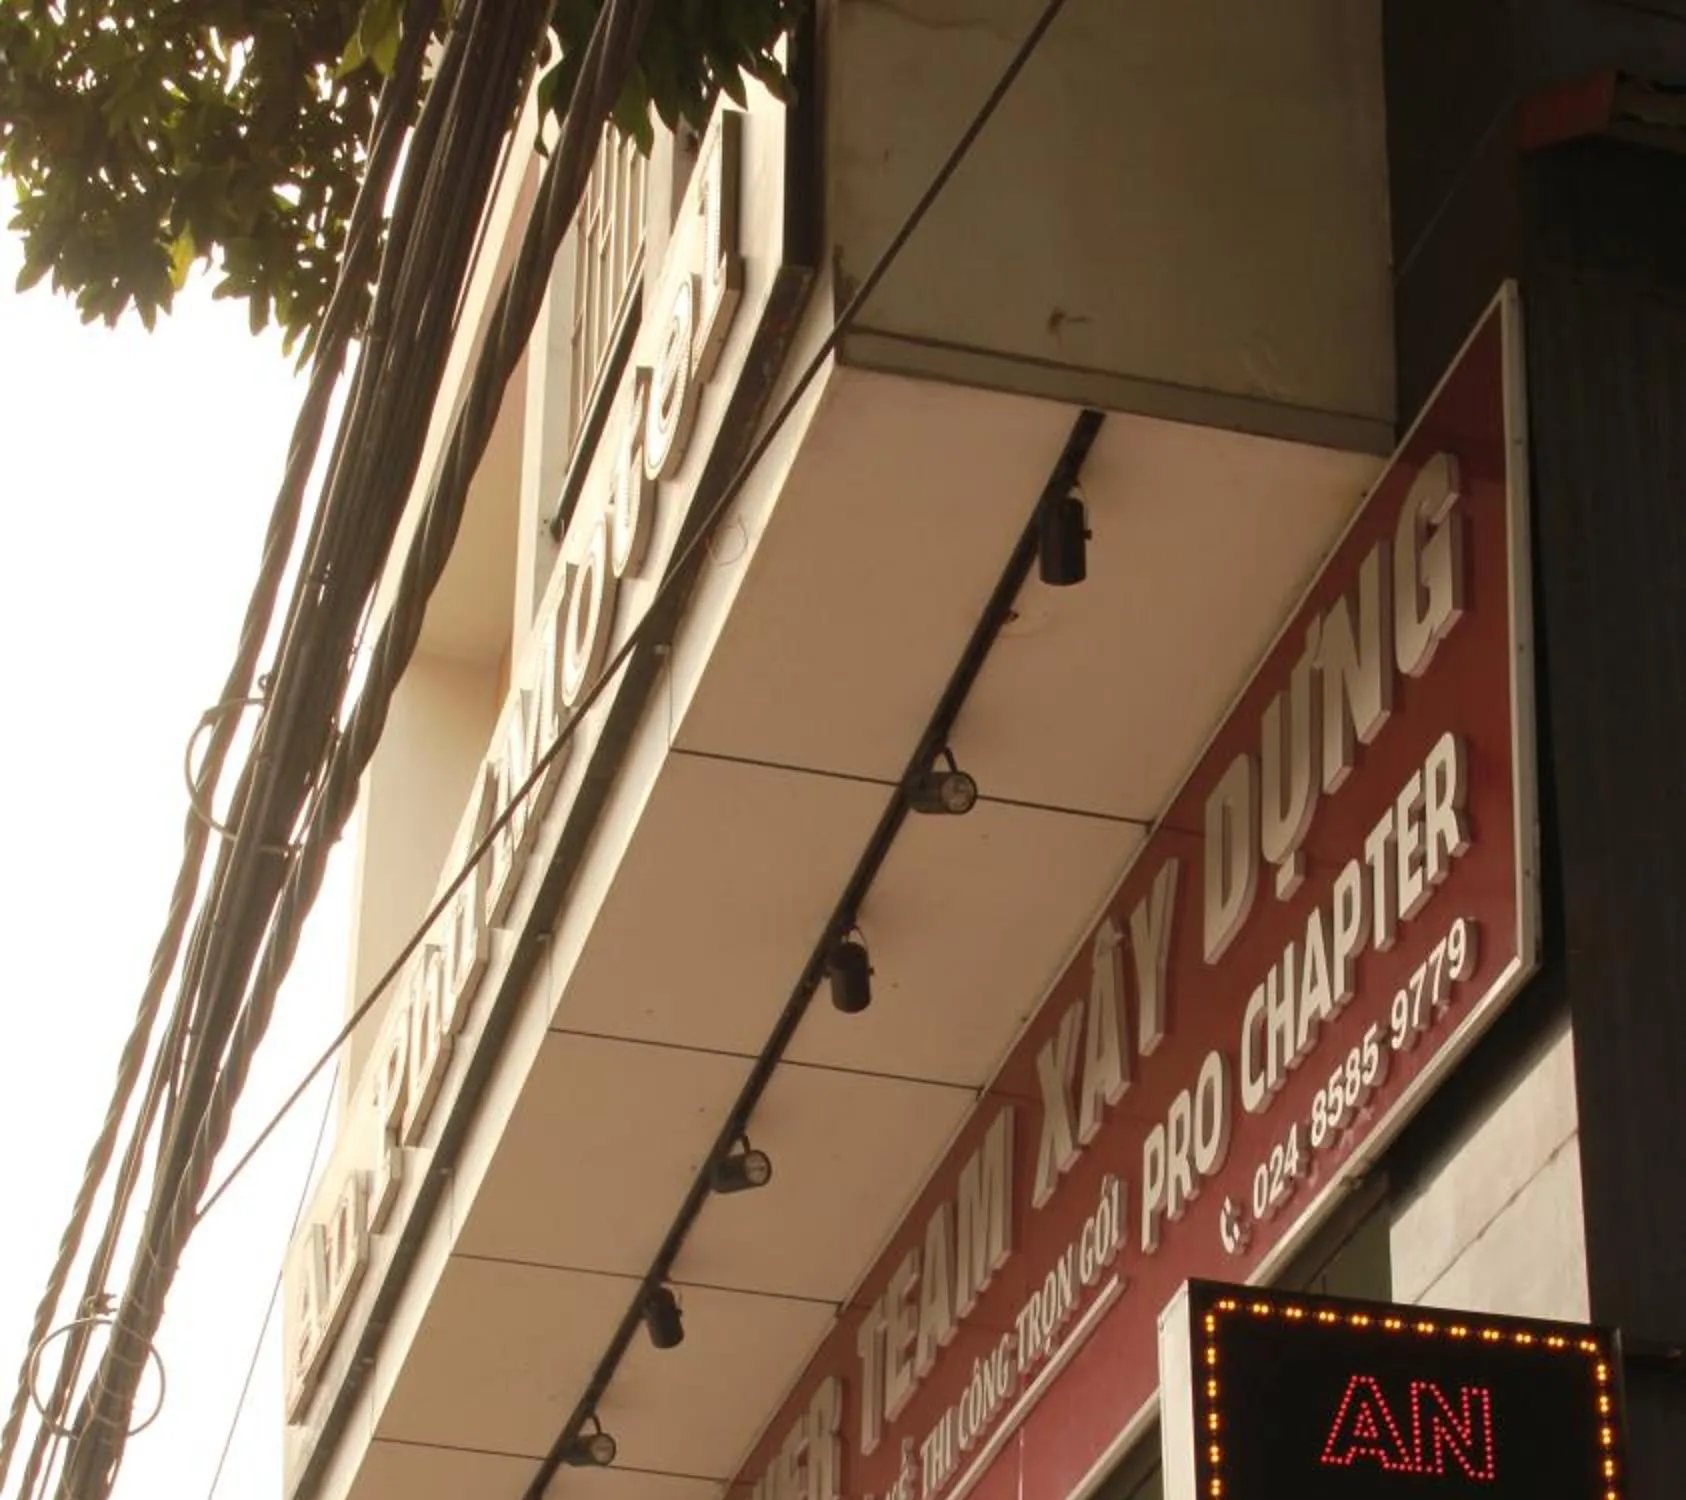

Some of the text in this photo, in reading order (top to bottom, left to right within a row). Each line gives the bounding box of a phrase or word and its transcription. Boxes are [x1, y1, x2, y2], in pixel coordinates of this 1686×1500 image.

[857, 1104, 1011, 1455] TEAM
[1032, 857, 1179, 1209] XÂY
[1203, 451, 1463, 964] DỰNG
[1141, 731, 1470, 1254] PRO CHAPTER
[1252, 917, 1473, 1219] 024 8585 9779
[958, 1332, 1013, 1450] CÔNG
[1015, 1243, 1075, 1373] TRỌN
[1079, 1173, 1123, 1285] GÓI
[1321, 1375, 1495, 1480] AN
